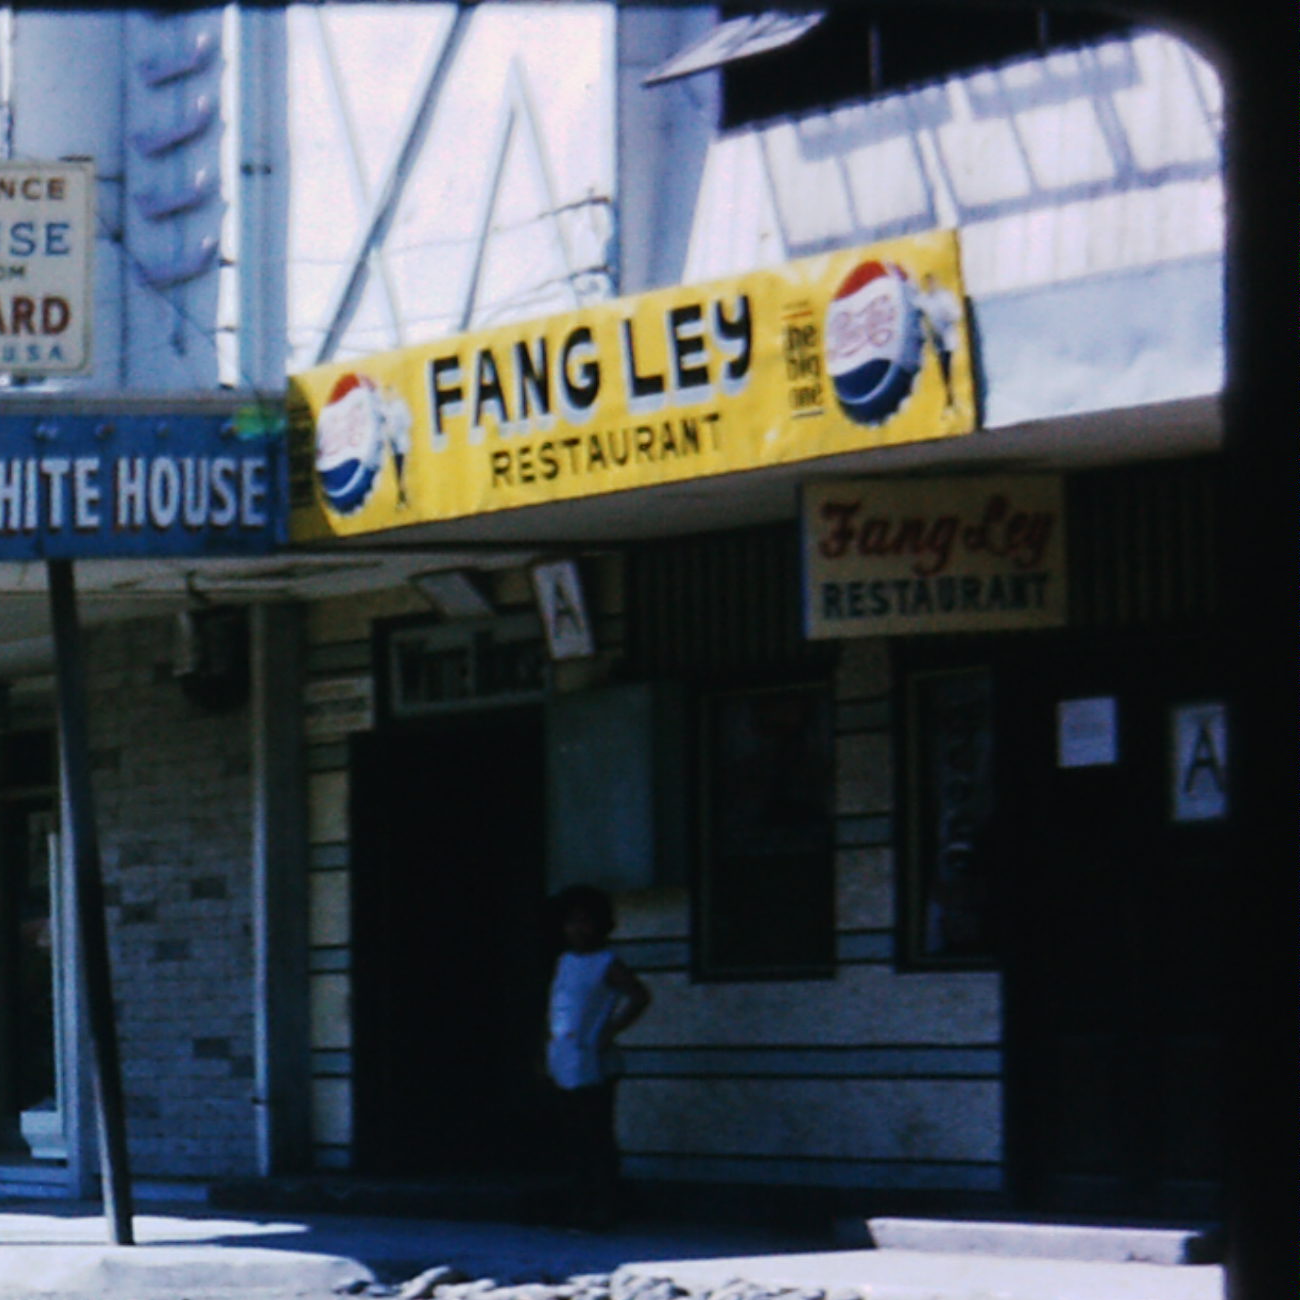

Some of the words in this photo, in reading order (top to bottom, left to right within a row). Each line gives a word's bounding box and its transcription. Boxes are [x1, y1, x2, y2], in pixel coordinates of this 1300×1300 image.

[428, 325, 601, 440] FANG
[621, 294, 754, 401] LEY
[490, 411, 722, 489] RESTAURANT
[116, 457, 269, 530] HOUSE
[819, 500, 960, 577] Fang
[961, 495, 1055, 570] Ley
[549, 575, 586, 640] A
[821, 571, 1052, 620] RESTAURANT
[1184, 718, 1226, 795] A
